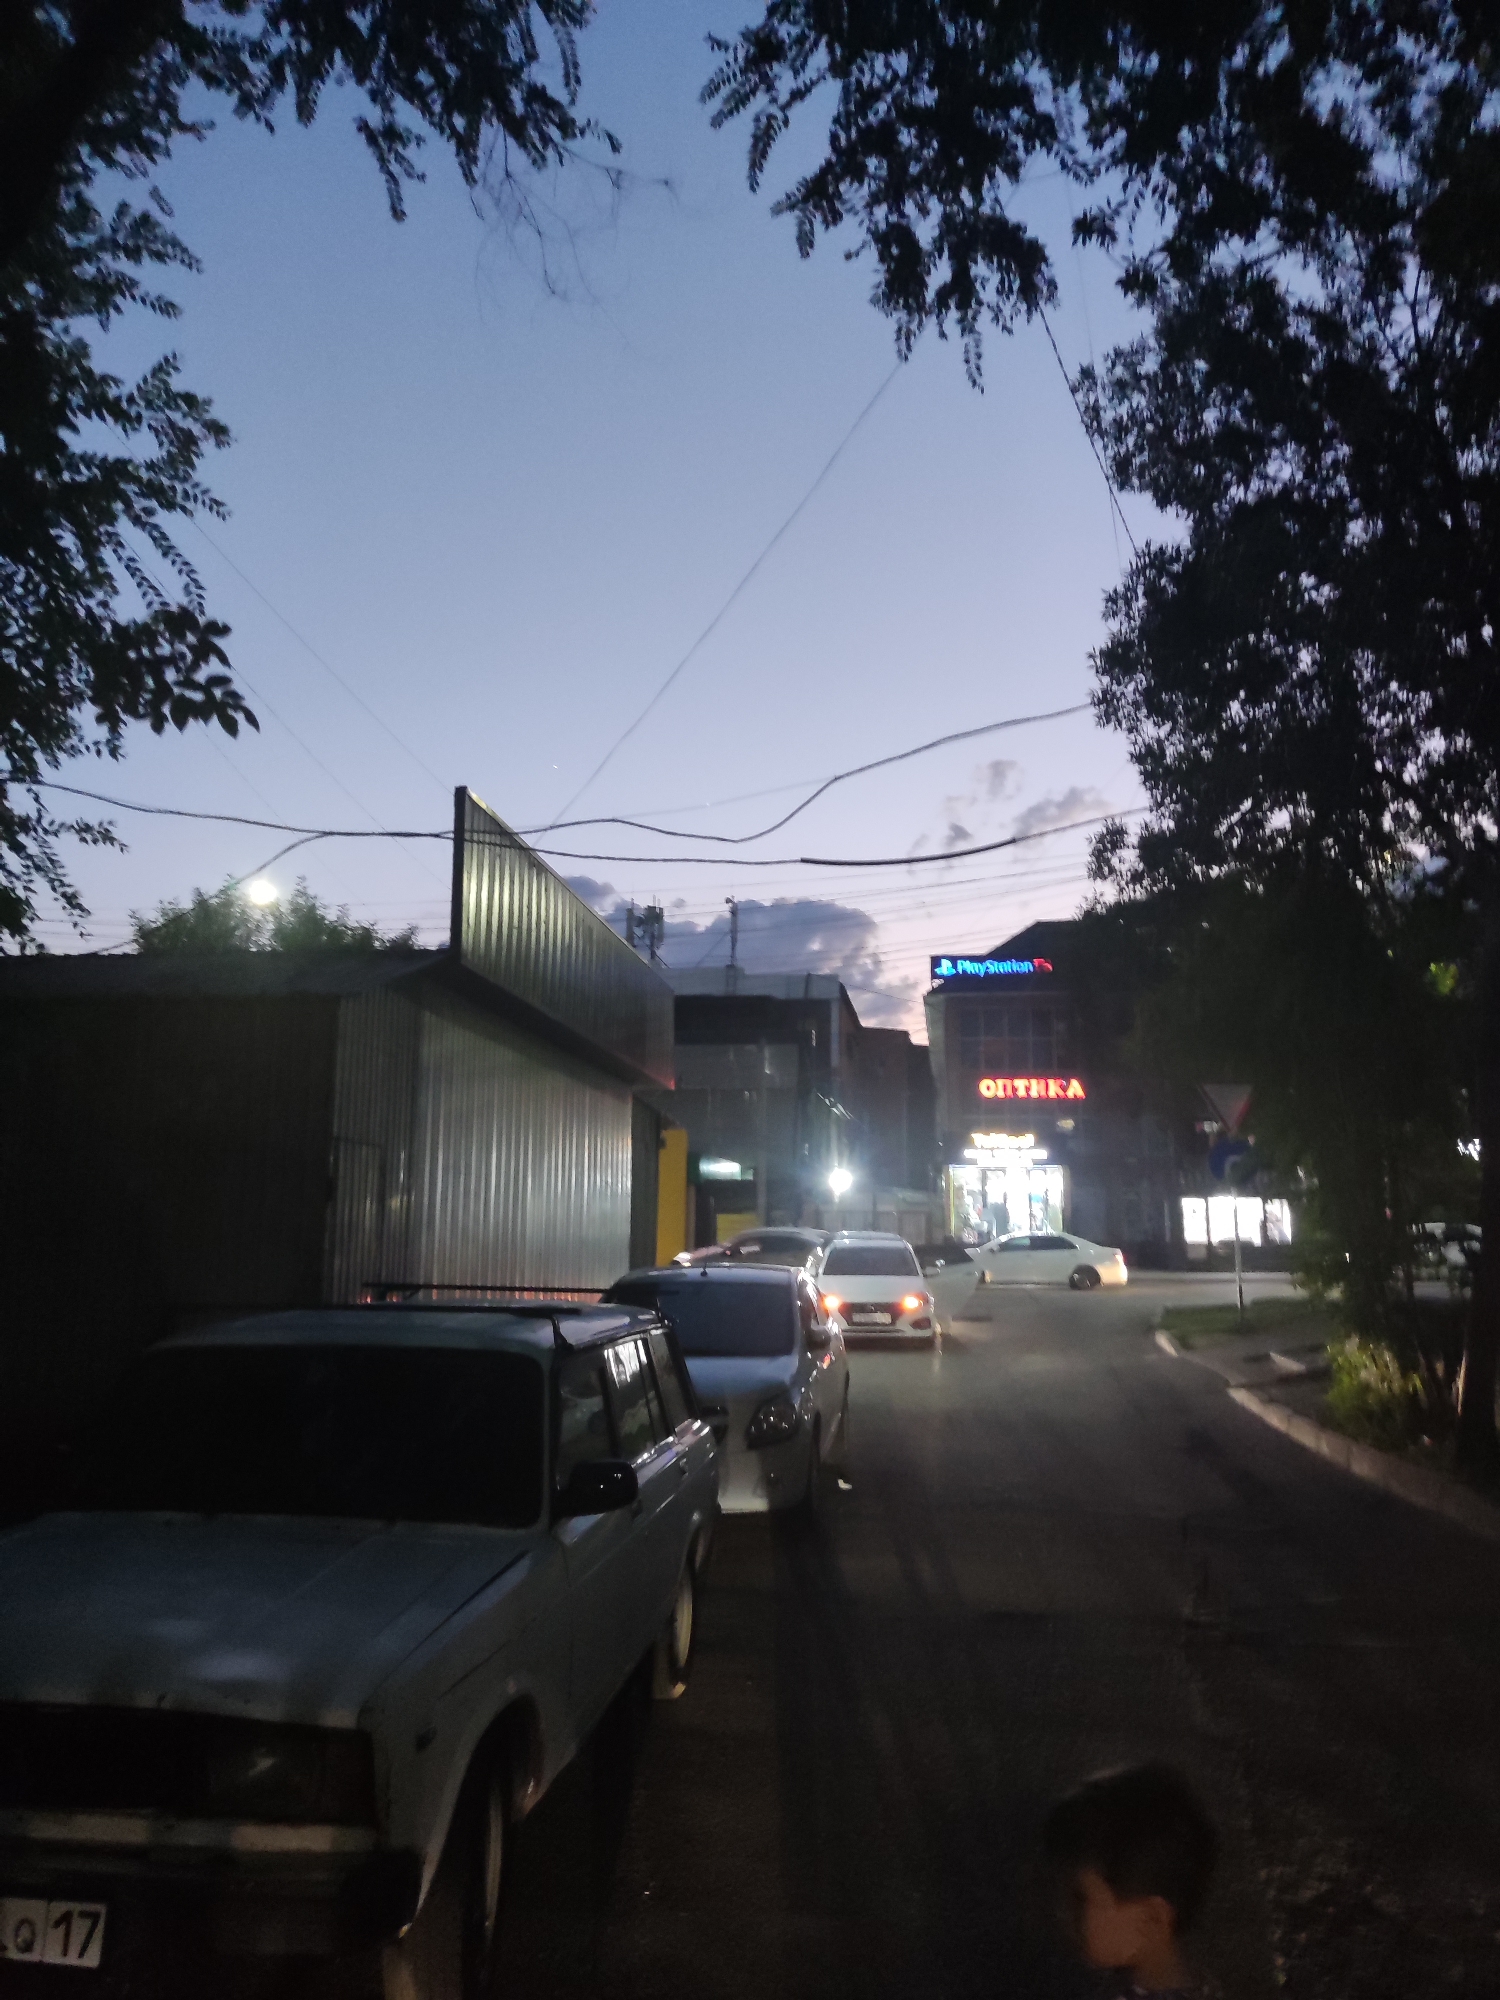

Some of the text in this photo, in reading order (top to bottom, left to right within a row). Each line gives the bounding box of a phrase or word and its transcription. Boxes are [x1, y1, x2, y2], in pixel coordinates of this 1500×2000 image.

[956, 958, 1034, 977] PlayStation
[978, 1077, 1086, 1100] ОПТИКА
[51, 1909, 101, 1959] 17
